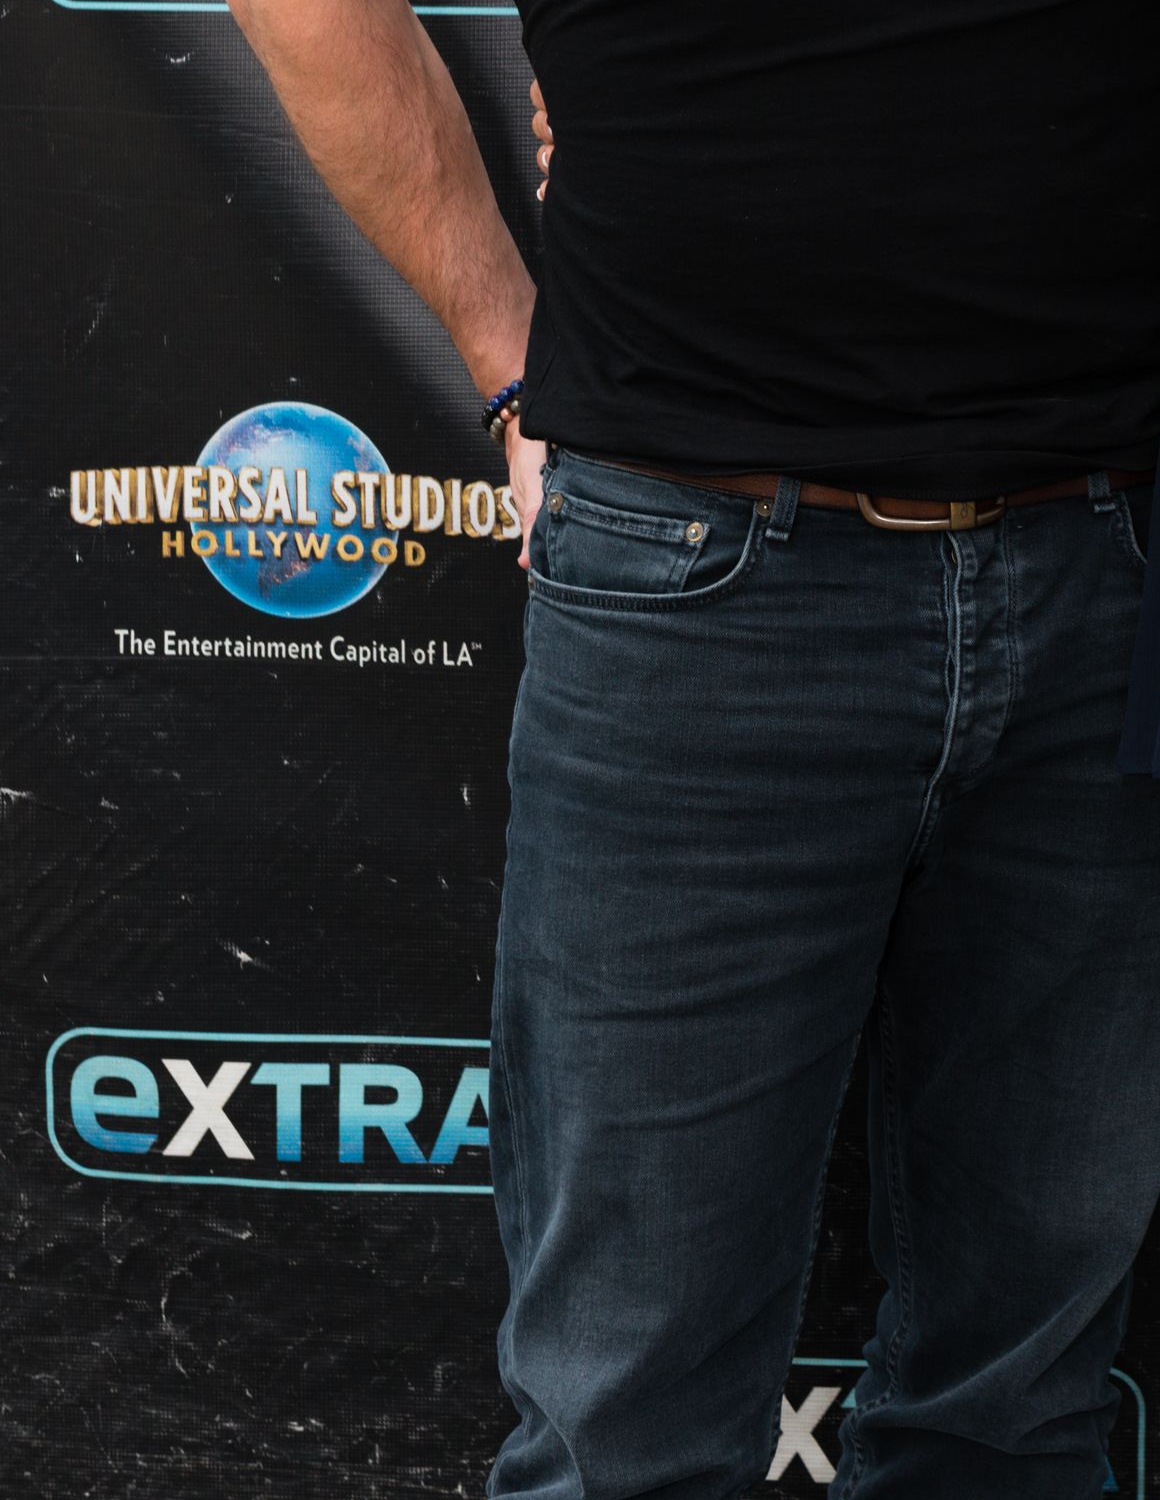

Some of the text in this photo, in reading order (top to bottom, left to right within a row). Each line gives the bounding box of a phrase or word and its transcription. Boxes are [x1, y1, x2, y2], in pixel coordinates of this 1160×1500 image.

[69, 466, 523, 541] UNIVERSAL STUDIOS
[162, 530, 426, 567] HOLLYWOOD
[114, 629, 156, 655] The
[163, 630, 323, 660] Entertainment
[329, 635, 406, 667] Capital
[413, 640, 437, 665] of
